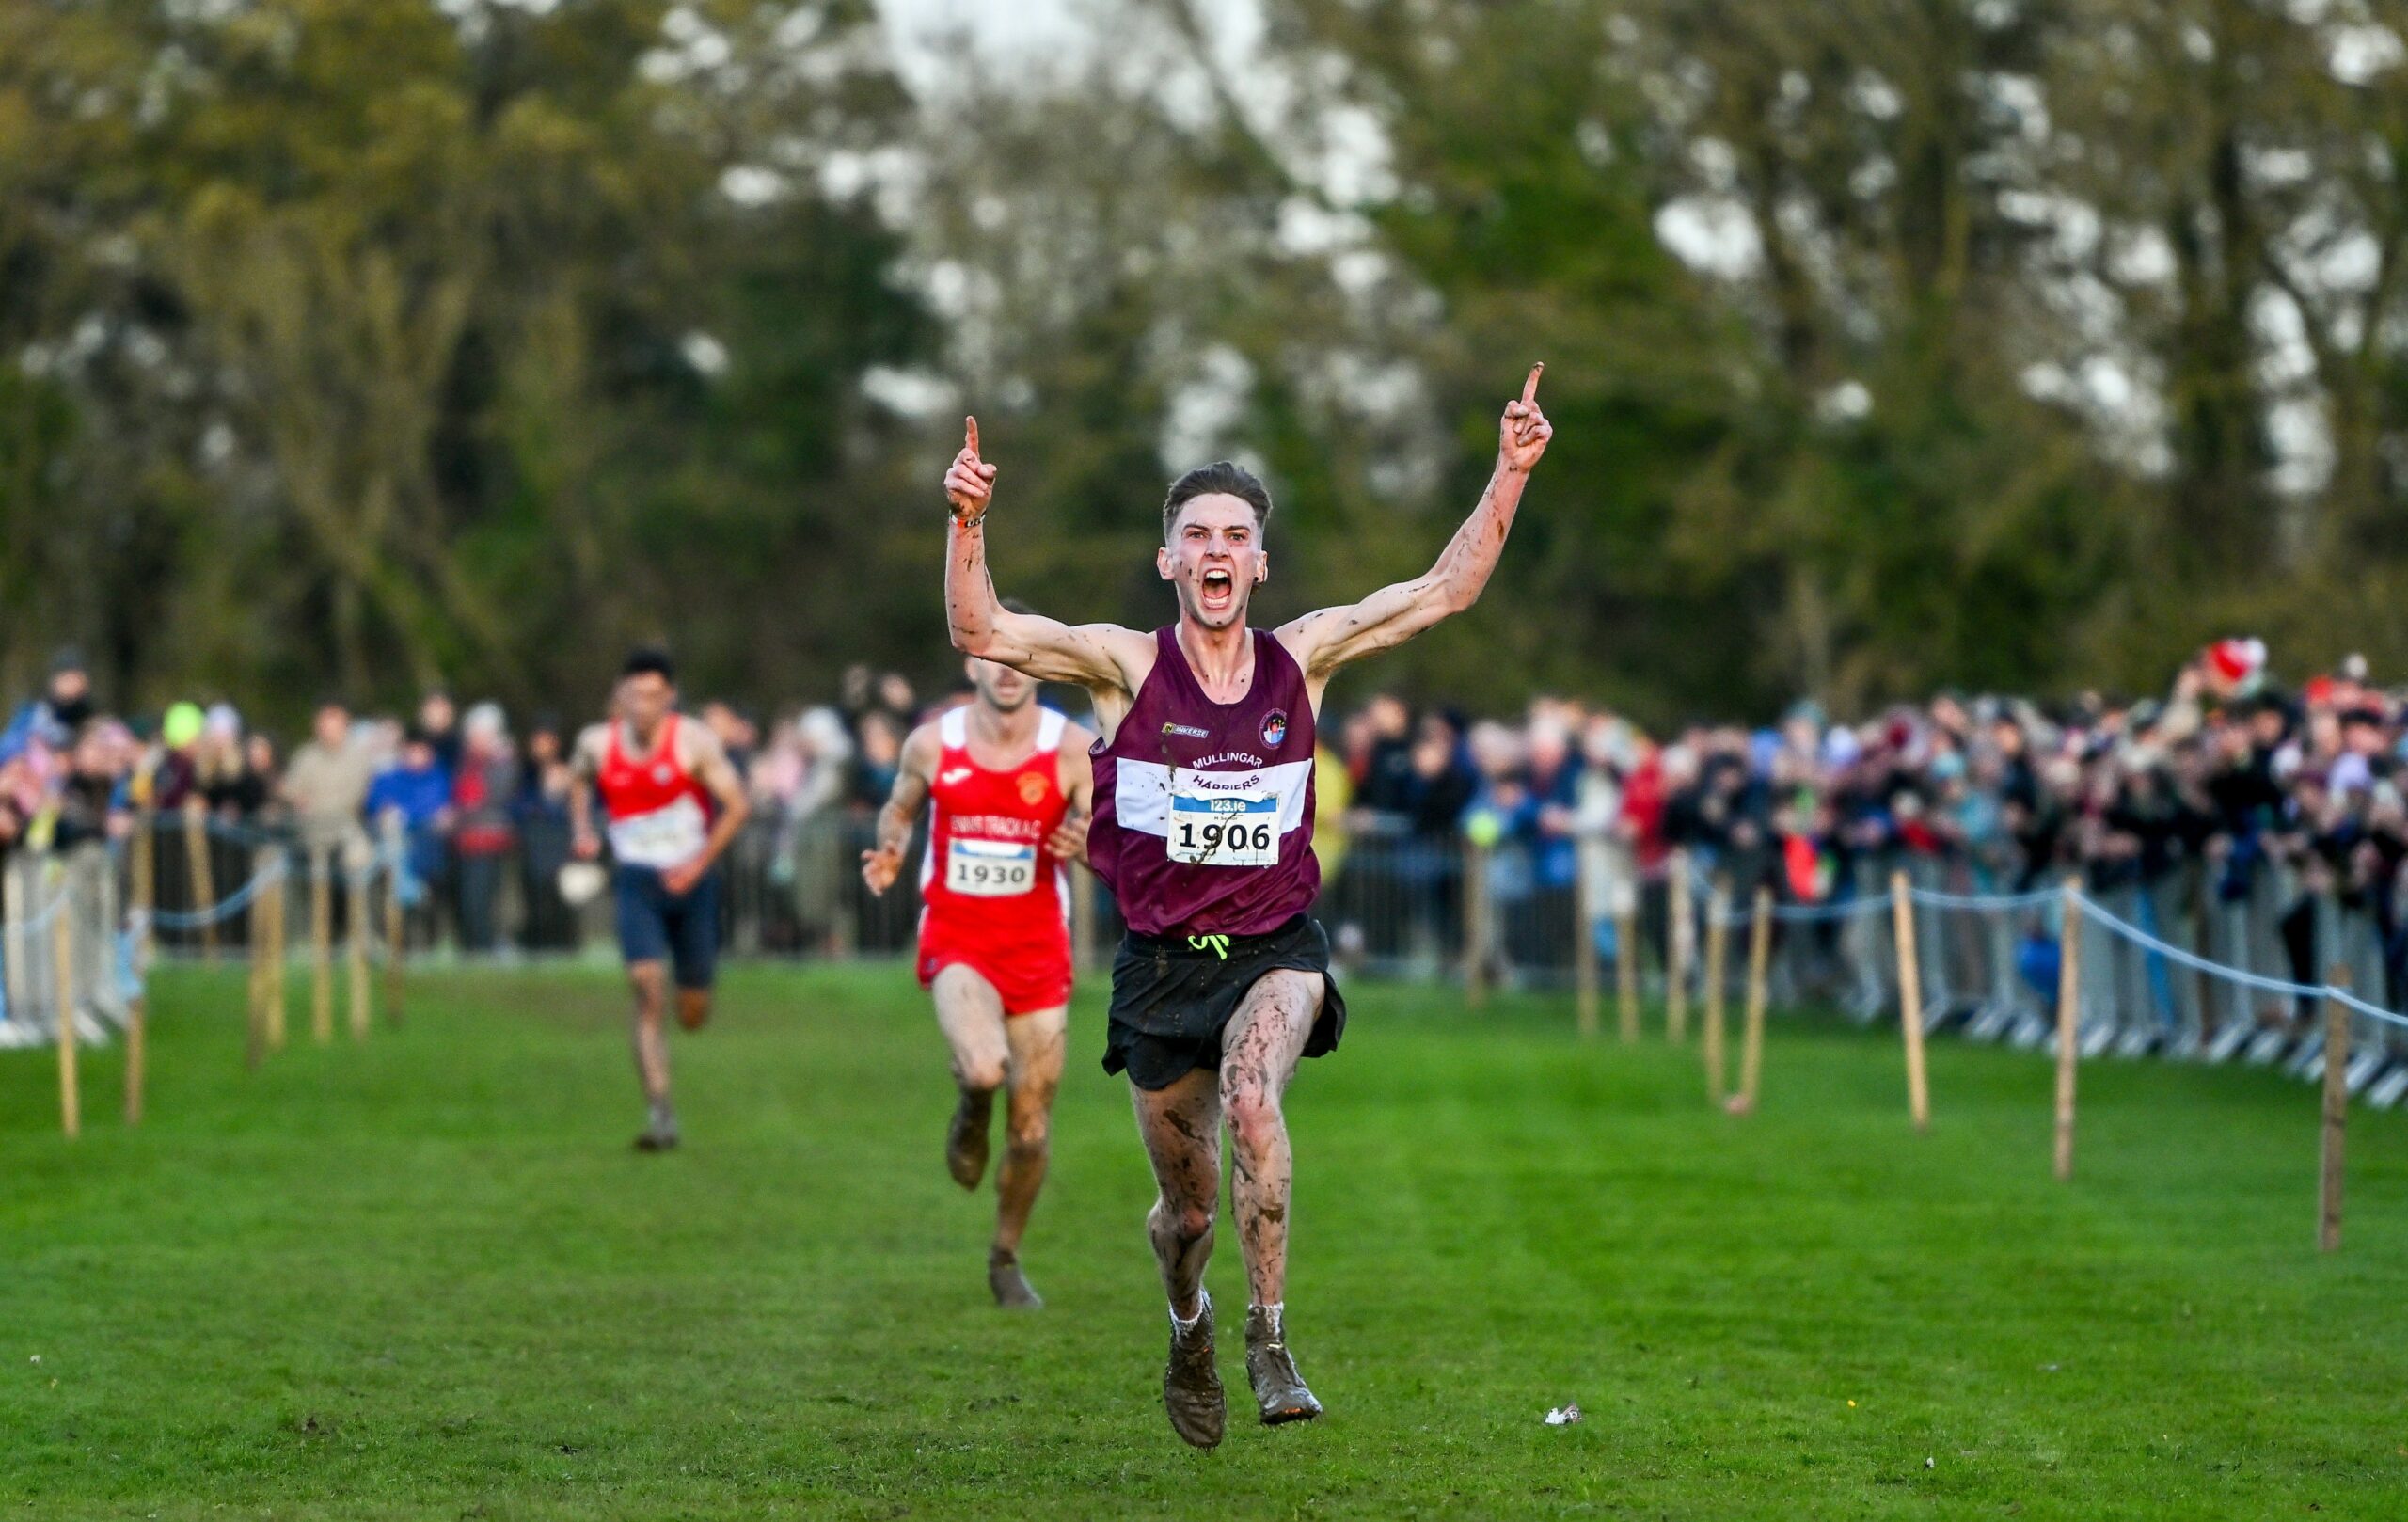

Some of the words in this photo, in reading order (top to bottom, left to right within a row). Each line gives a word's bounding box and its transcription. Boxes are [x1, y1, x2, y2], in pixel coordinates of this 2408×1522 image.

[1175, 725, 1207, 737] INVERSE
[1192, 753, 1263, 769] MULLINGAR
[1193, 775, 1259, 790] HARRIERS
[1179, 822, 1270, 850] 1906
[957, 863, 1025, 883] 1930
